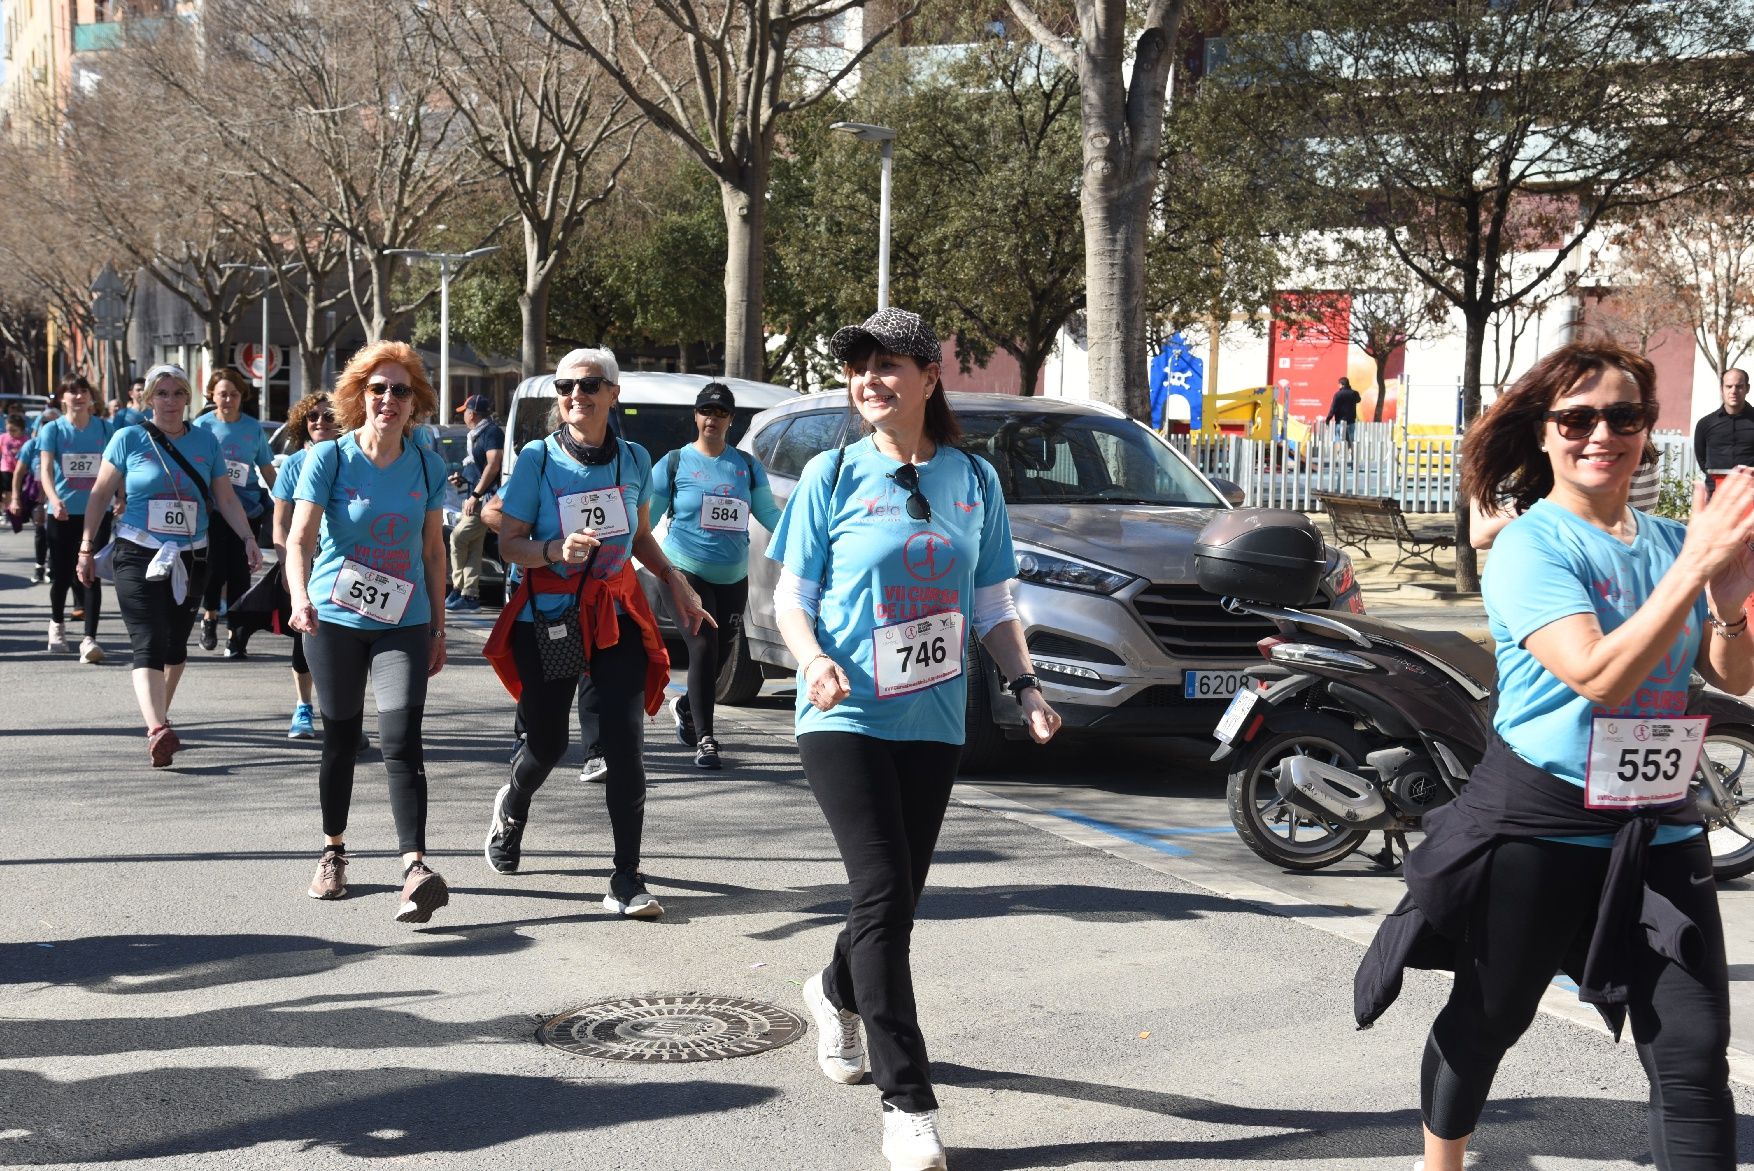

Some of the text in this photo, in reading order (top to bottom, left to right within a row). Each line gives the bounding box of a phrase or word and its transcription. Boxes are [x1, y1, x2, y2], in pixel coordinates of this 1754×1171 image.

[70, 461, 93, 471] 287
[164, 511, 184, 525] 60
[580, 506, 606, 527] 79
[711, 507, 739, 522] 584
[349, 580, 390, 610] 531
[884, 586, 959, 604] VII CURSA
[876, 603, 897, 620] DE
[900, 604, 918, 620] LA
[896, 636, 947, 673] 746
[1199, 674, 1250, 695] 6208
[1616, 748, 1682, 782] 553
